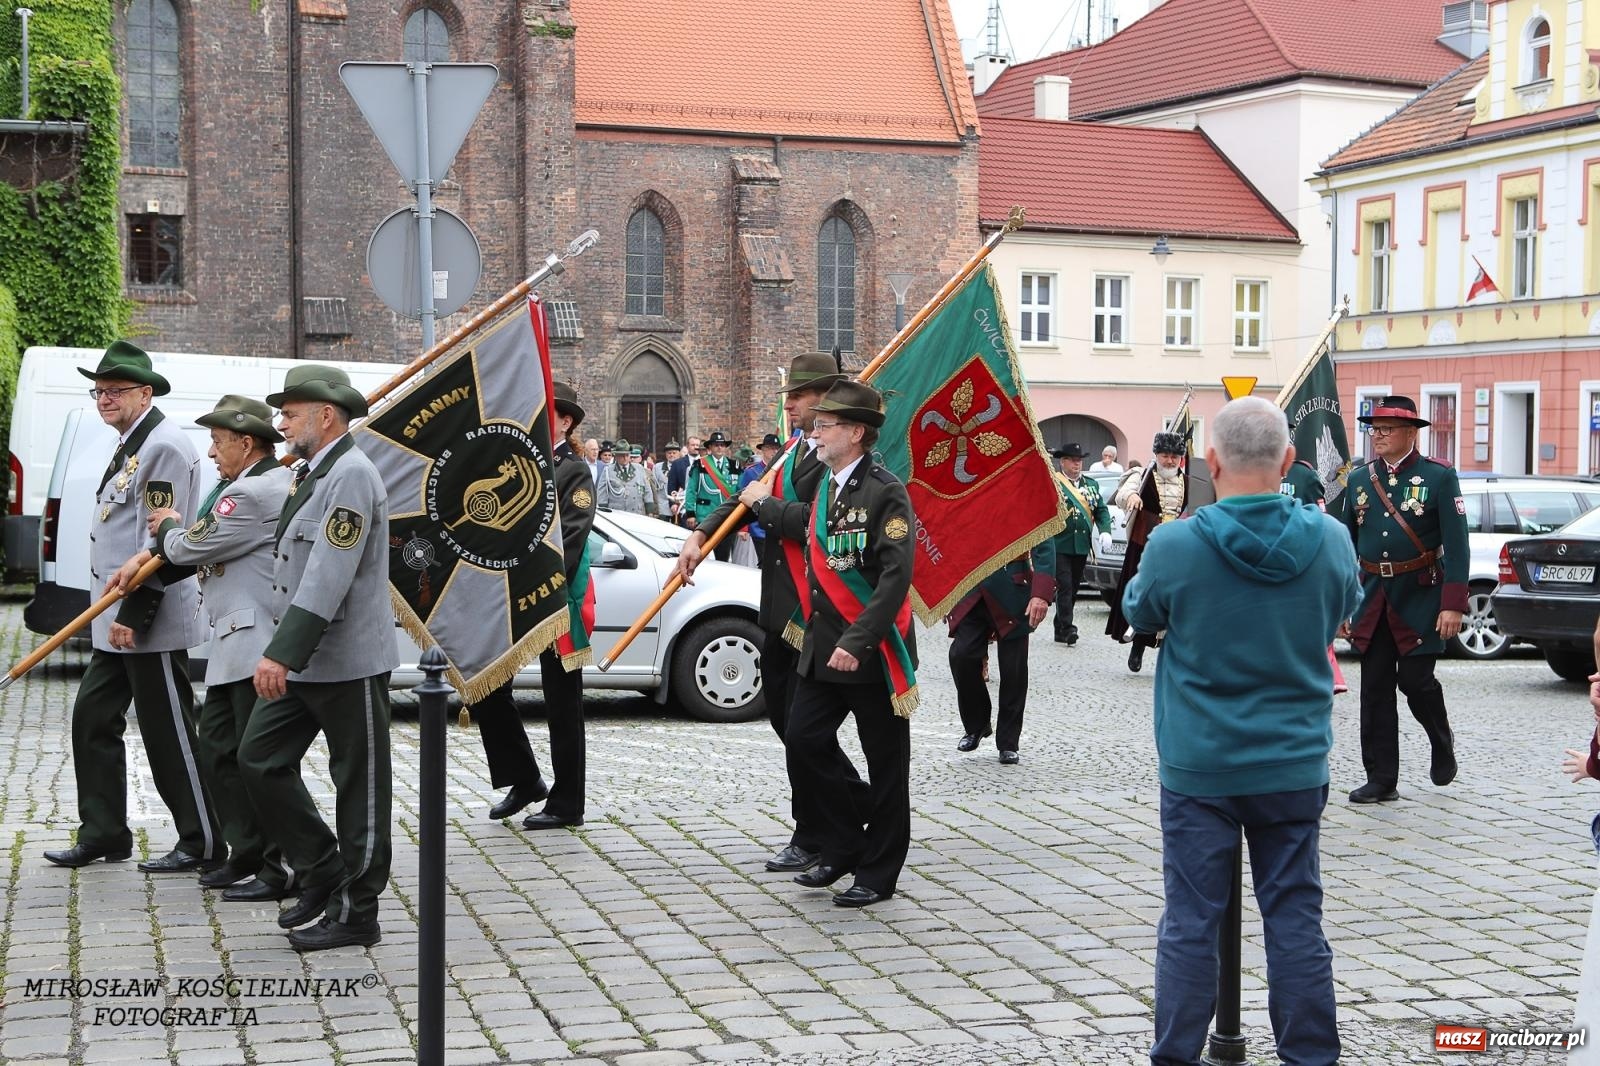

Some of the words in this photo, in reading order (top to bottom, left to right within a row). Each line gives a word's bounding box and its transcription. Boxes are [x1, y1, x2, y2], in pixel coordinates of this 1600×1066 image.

[403, 386, 471, 439] STAŃMY
[427, 449, 452, 522] BRACTWO
[465, 425, 548, 470] RACIBORSKIE
[527, 479, 555, 553] KURKOWE
[439, 530, 520, 569] STRZELECKIE
[914, 513, 943, 565] RONIE
[1541, 566, 1565, 579] SRC
[1566, 567, 1593, 581] 6L97
